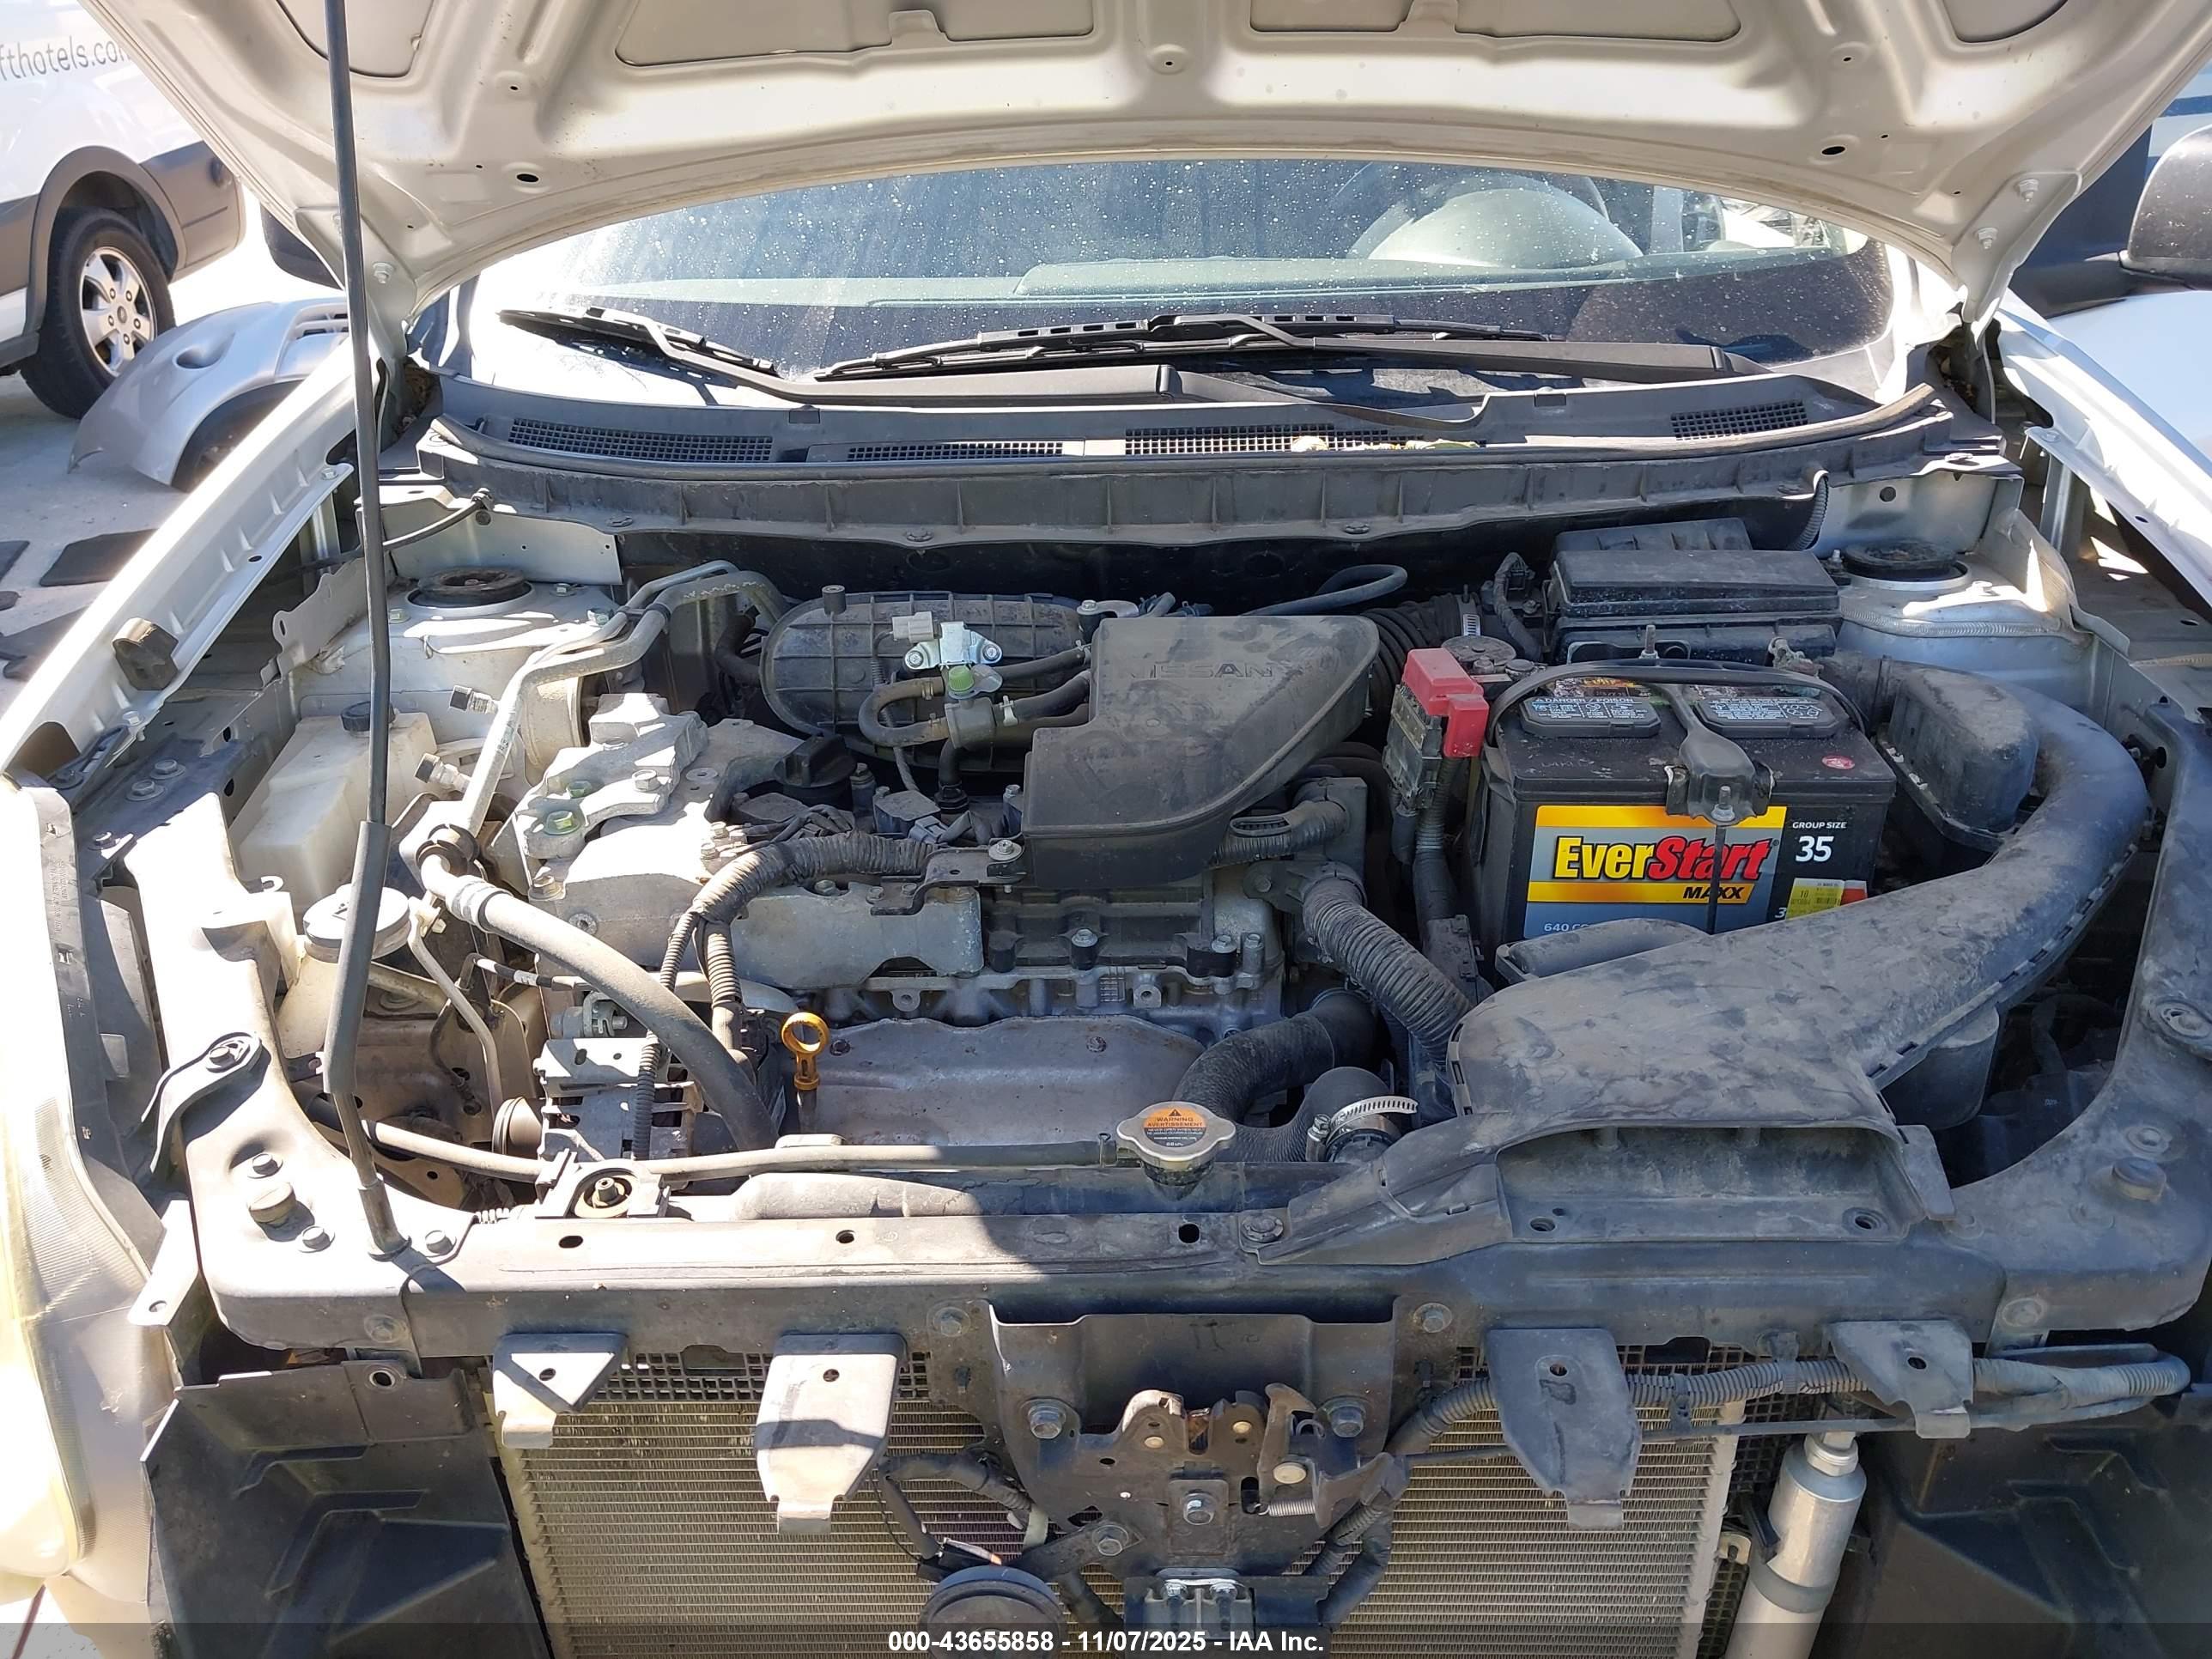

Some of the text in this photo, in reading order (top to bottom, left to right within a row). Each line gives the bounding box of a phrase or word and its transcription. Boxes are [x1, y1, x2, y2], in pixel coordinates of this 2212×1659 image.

[1792, 821, 1847, 830] GROUP SIZE
[1795, 835, 1835, 862] 35
[1544, 923, 1570, 932] 640
